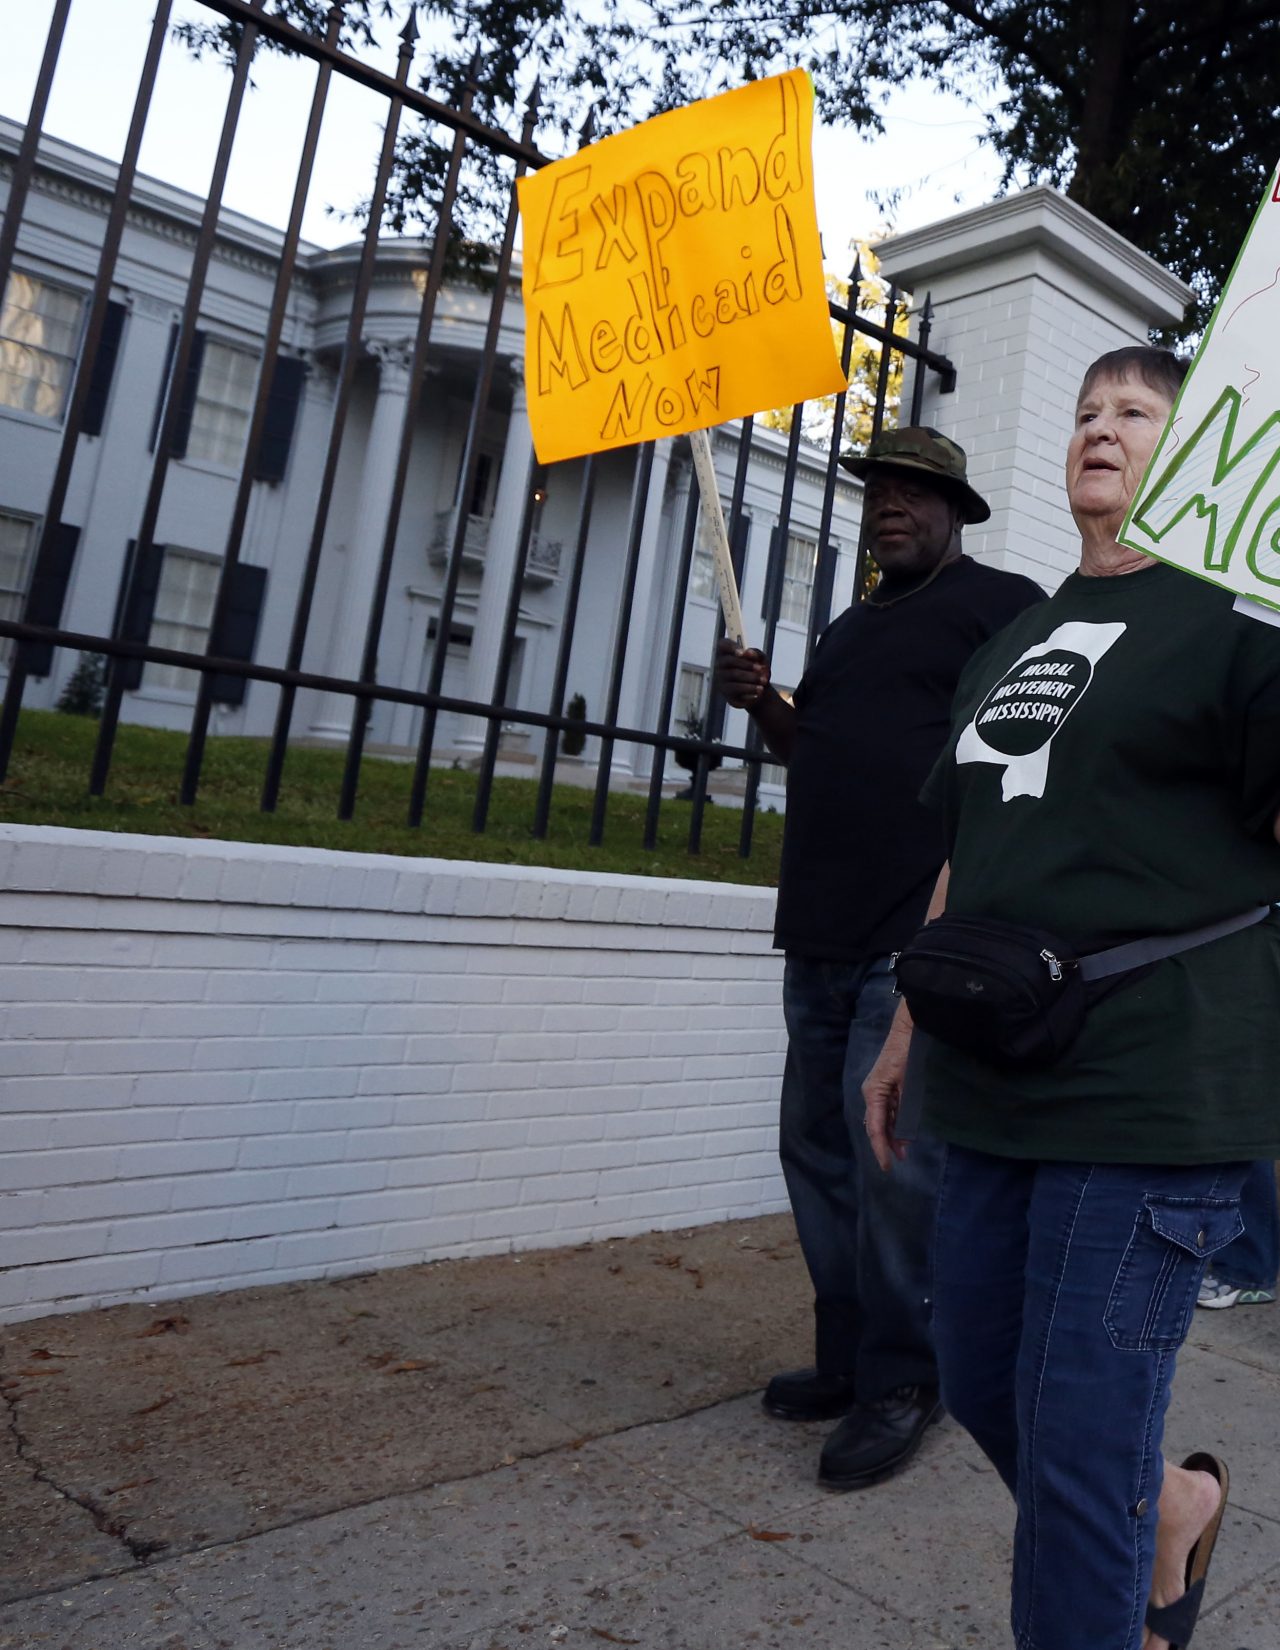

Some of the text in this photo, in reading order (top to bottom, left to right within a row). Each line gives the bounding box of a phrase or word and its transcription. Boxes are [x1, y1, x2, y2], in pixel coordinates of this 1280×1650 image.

[532, 75, 804, 311] Expand
[538, 204, 802, 396] Medicaid
[1019, 663, 1075, 678] MORAL
[991, 681, 1075, 702] MOVEMENT
[977, 702, 1063, 725] MISSISSIPPI
